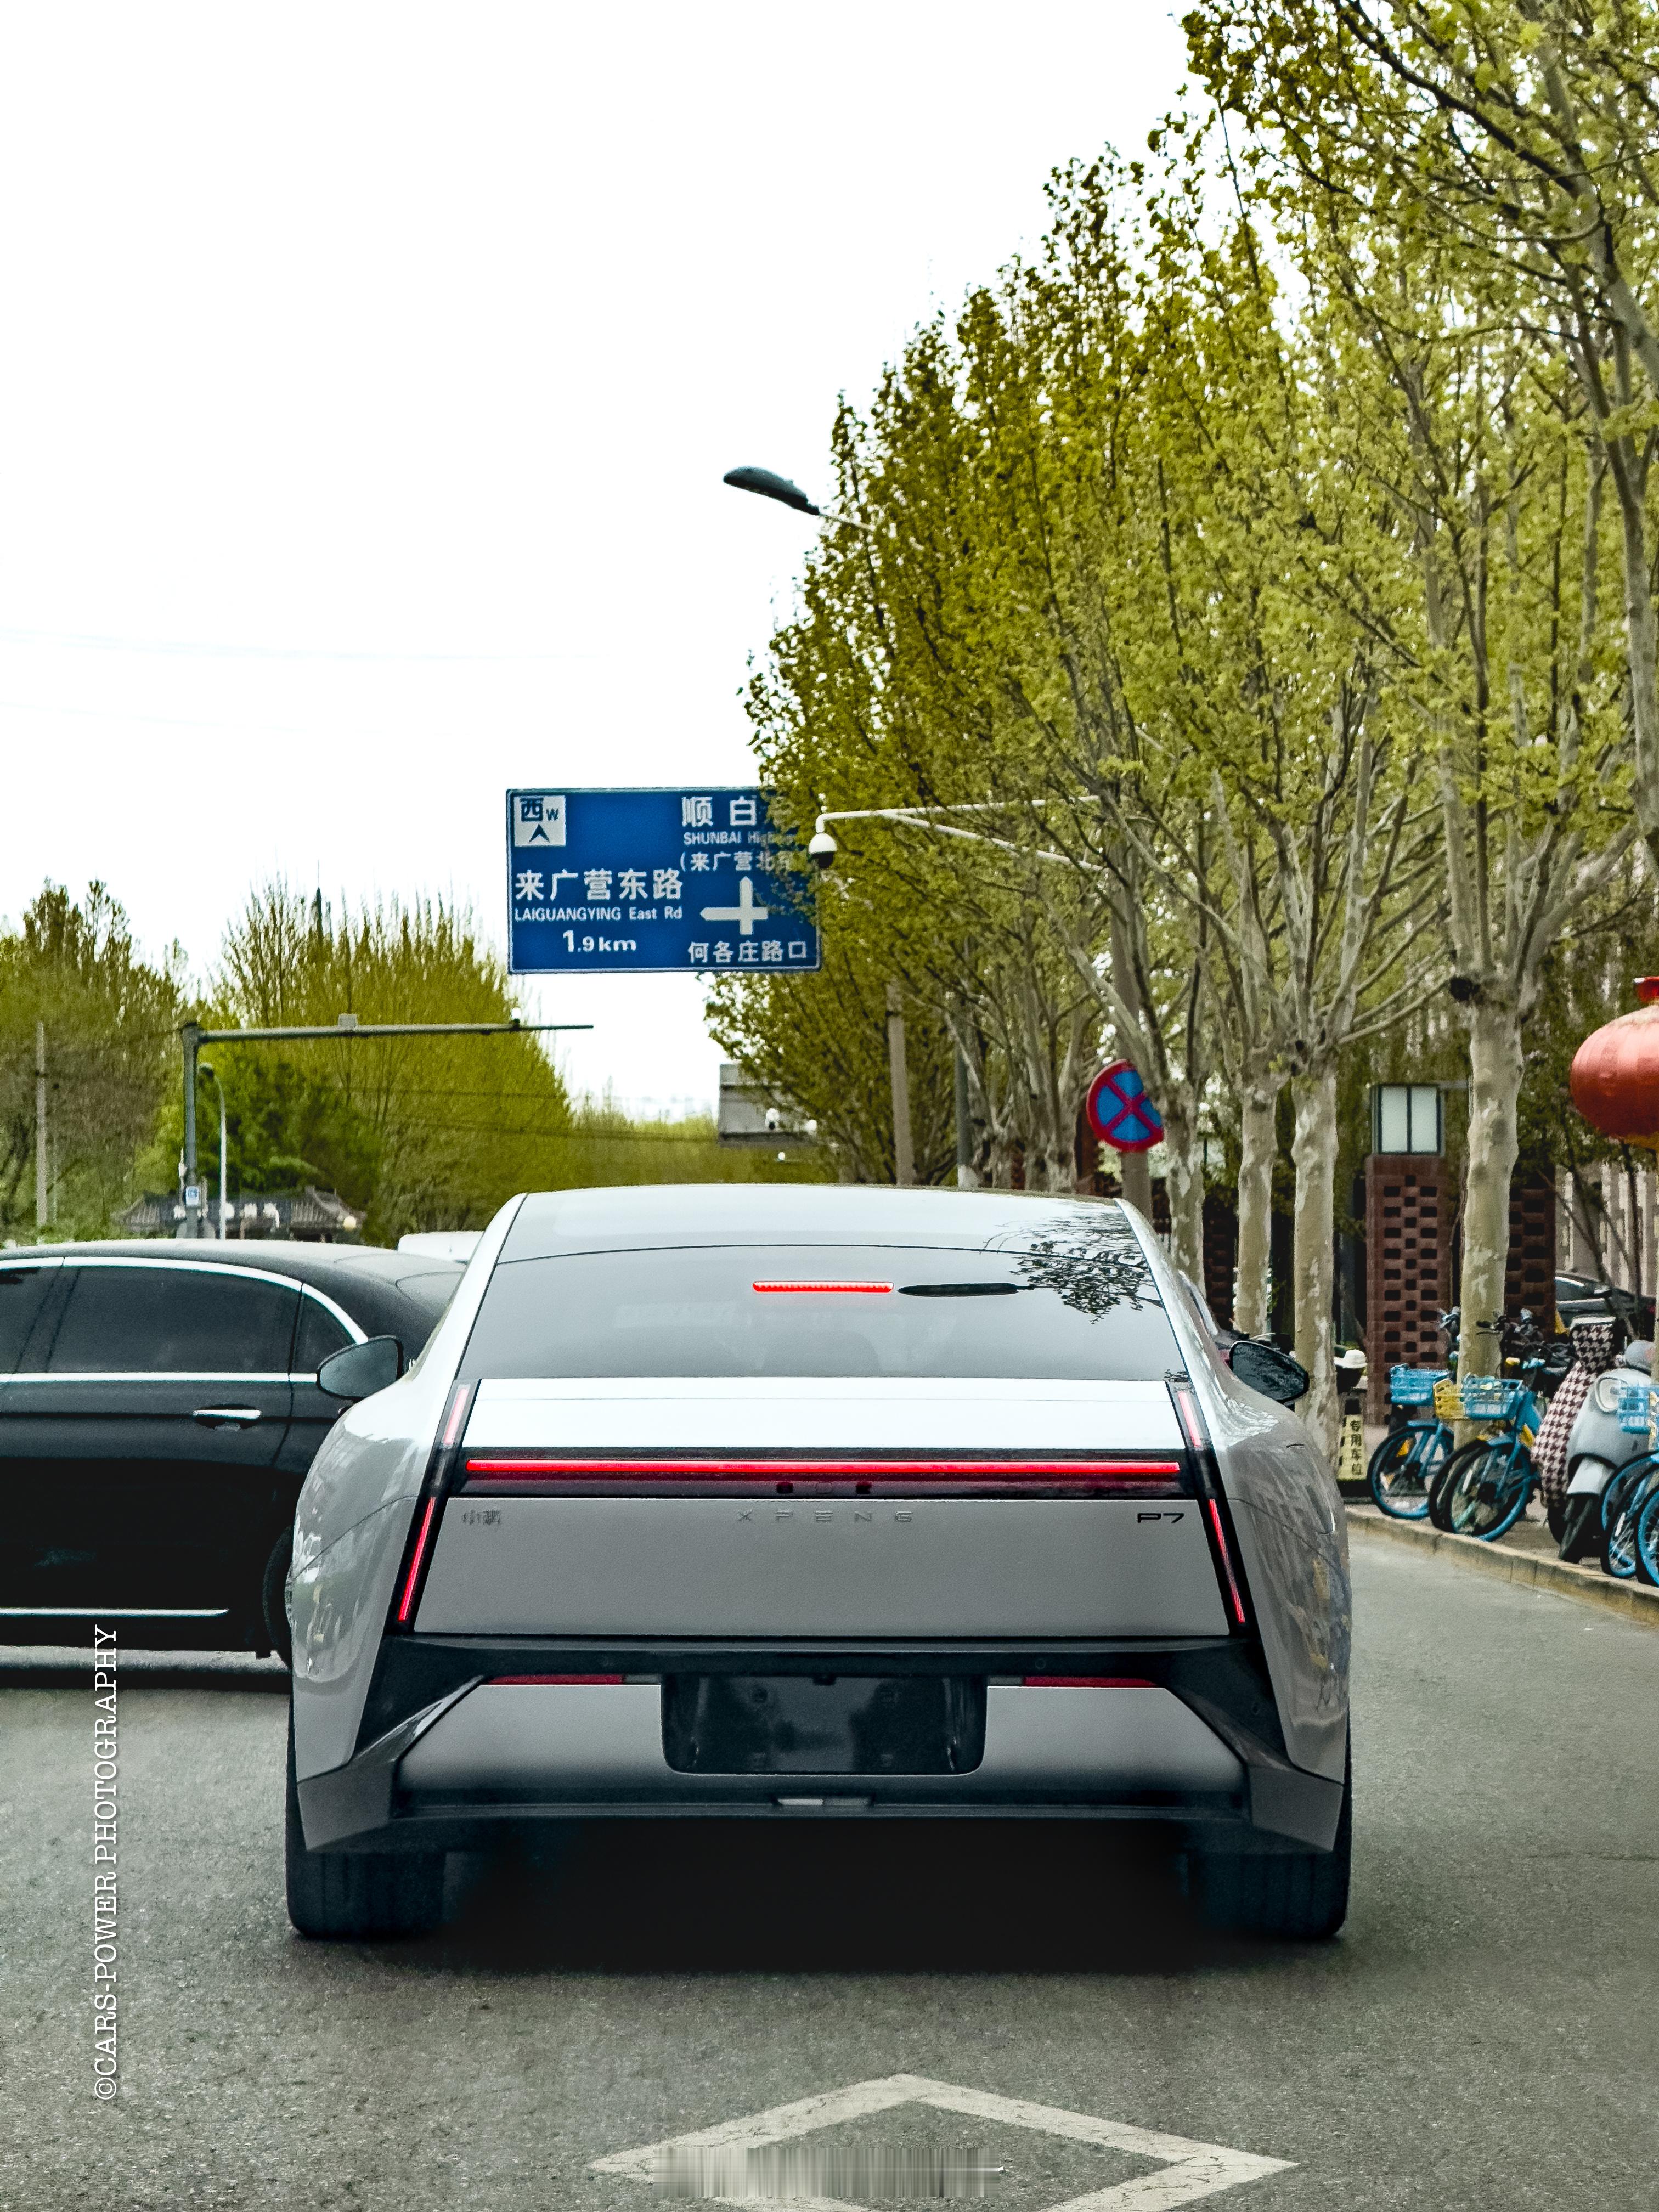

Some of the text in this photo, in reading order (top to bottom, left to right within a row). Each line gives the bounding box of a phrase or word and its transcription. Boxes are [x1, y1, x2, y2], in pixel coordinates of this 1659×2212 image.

[520, 798, 559, 822] 西 W
[684, 831, 741, 845] SHUNBAI
[515, 868, 684, 901] 来广营东路
[514, 905, 683, 922] LAIGUANGYING East Rd
[687, 940, 807, 964] 何各庄路口
[1137, 1513, 1185, 1523] P7
